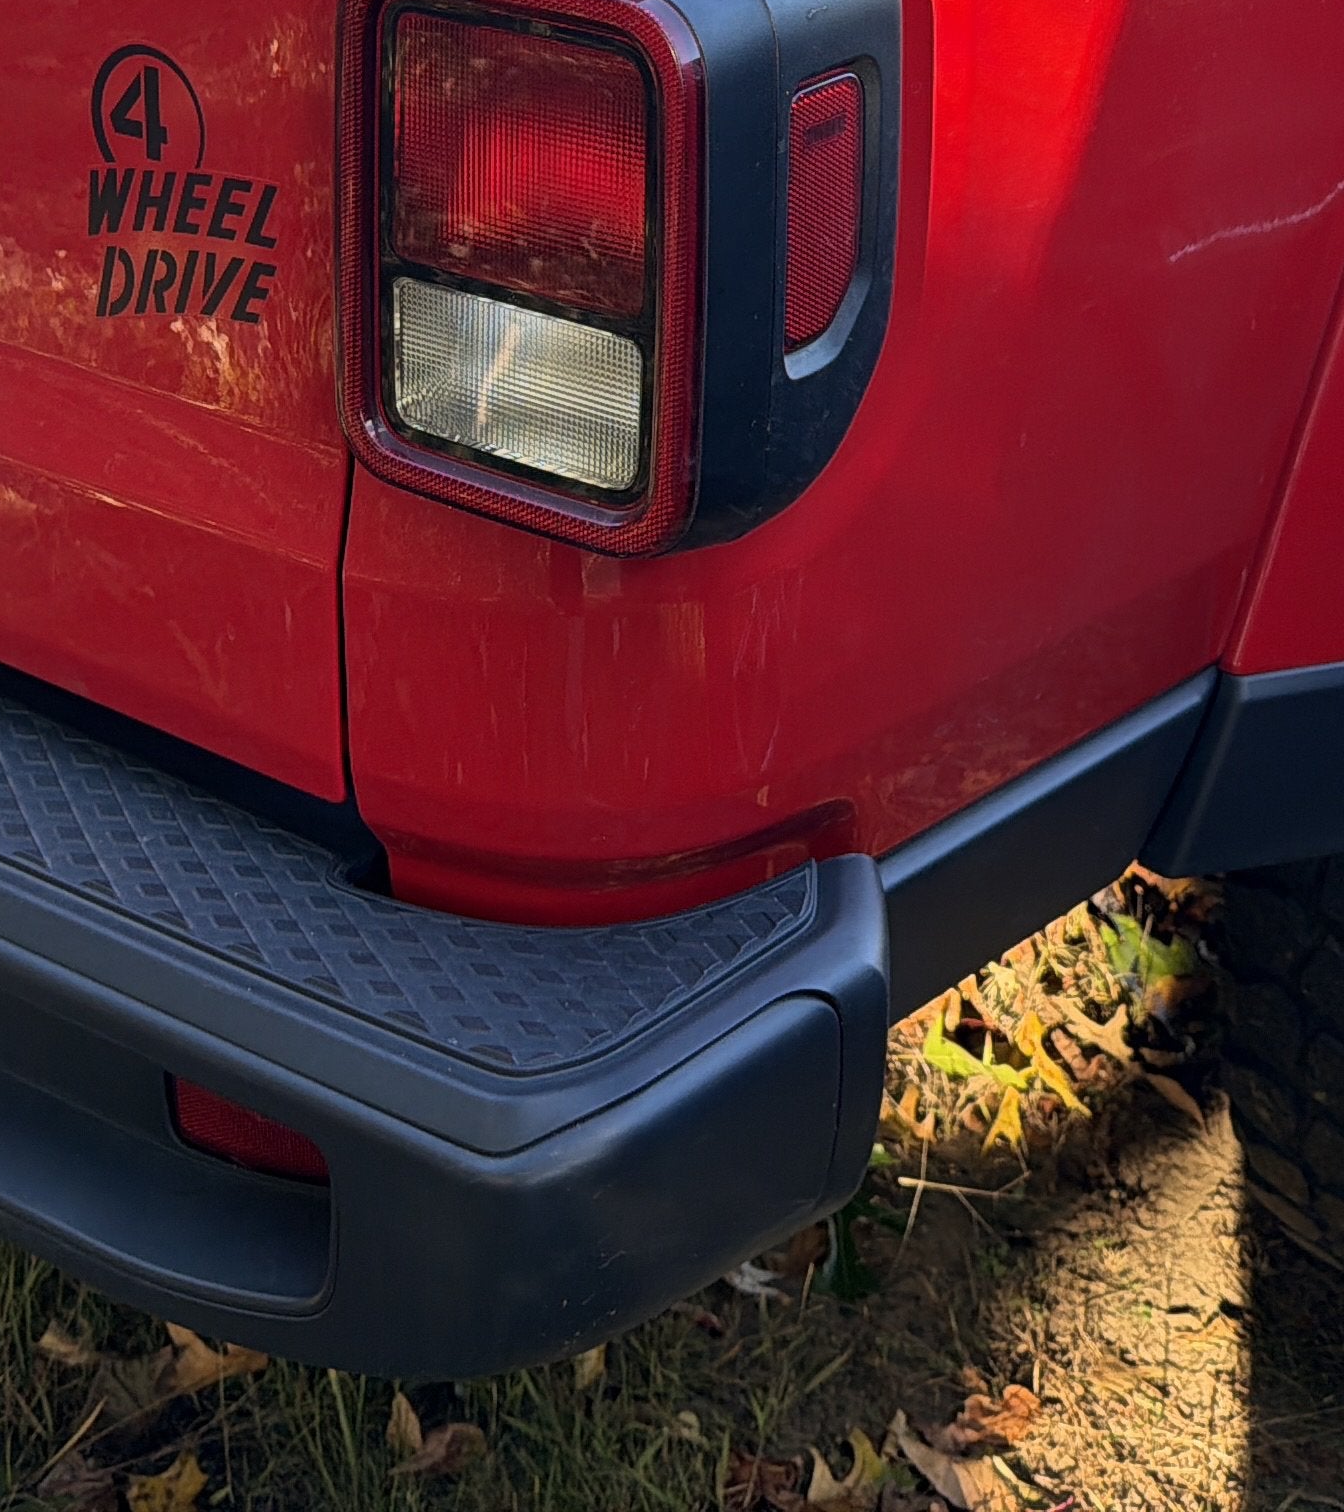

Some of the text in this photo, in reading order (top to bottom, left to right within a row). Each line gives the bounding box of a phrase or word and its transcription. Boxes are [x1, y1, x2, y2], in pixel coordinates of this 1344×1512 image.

[109, 65, 168, 161] 4
[87, 167, 278, 250] WHEEL
[95, 245, 278, 325] DRIVE
